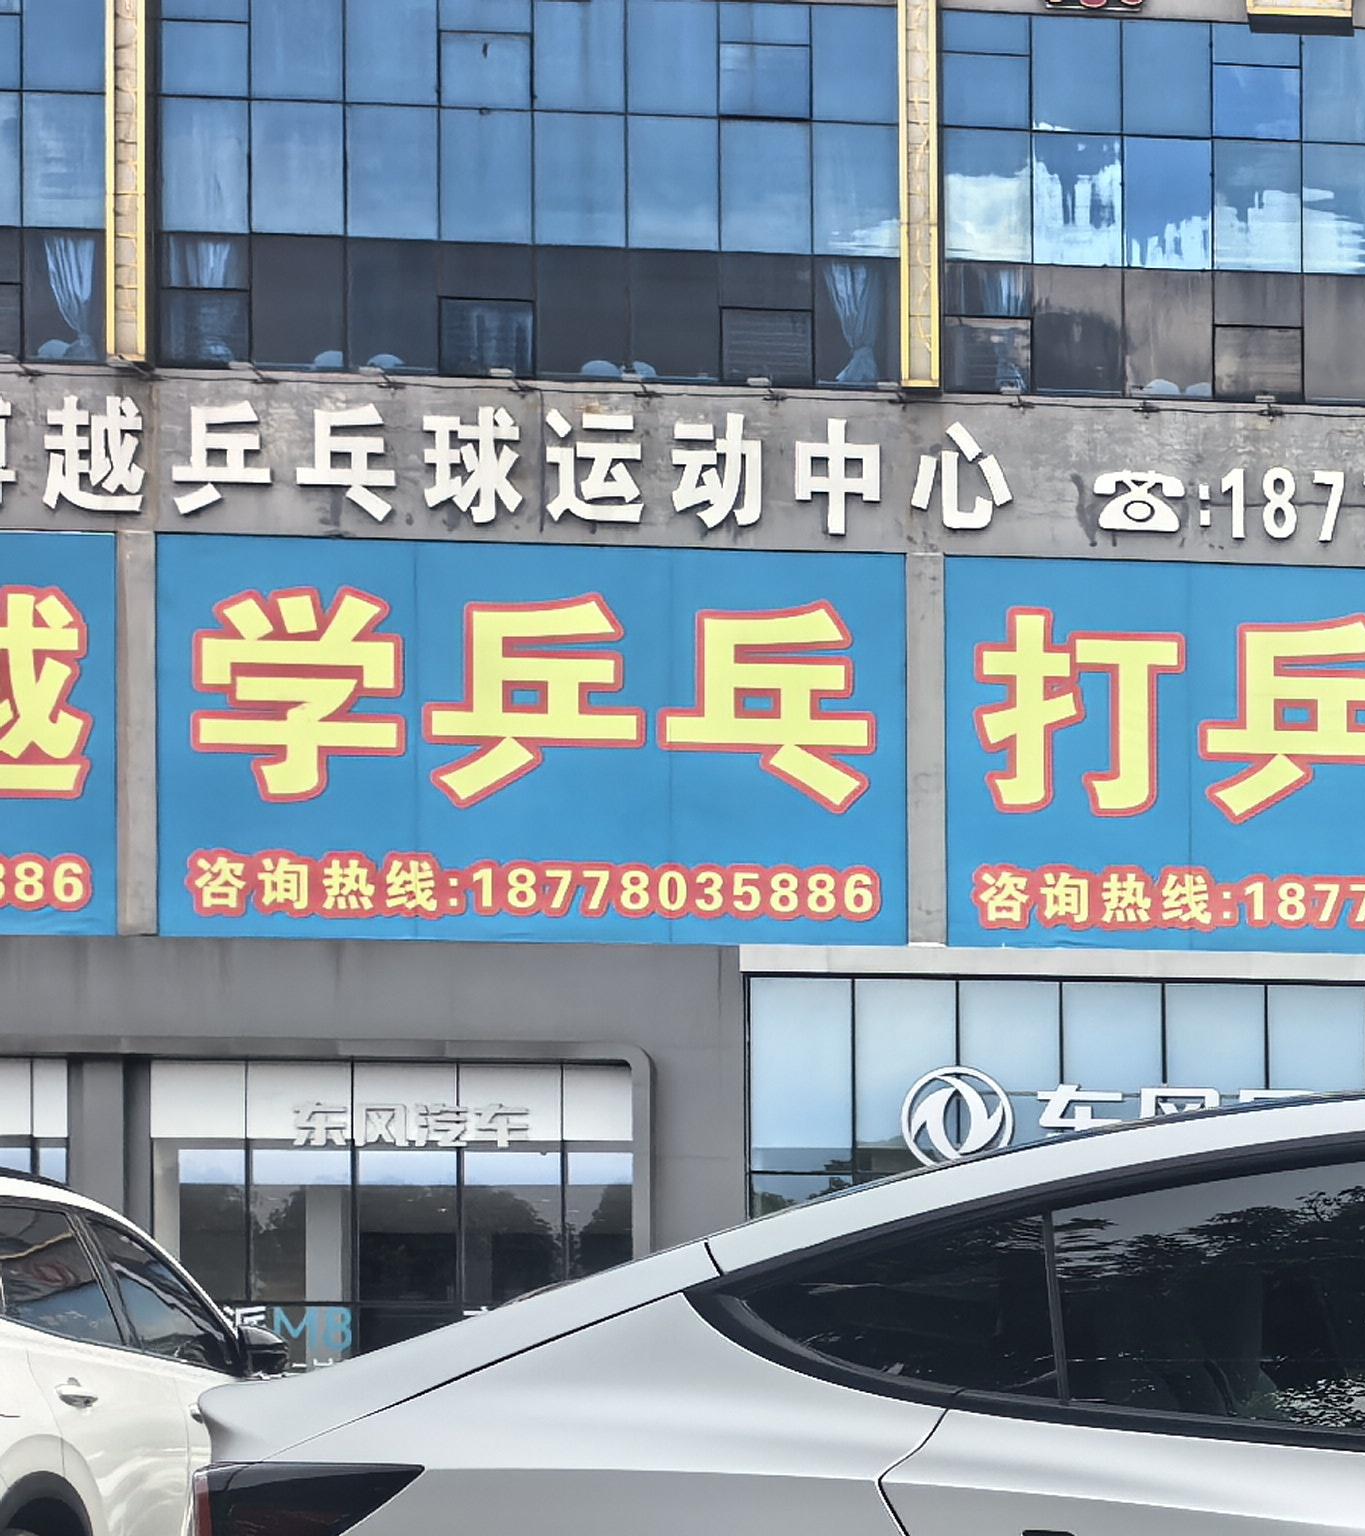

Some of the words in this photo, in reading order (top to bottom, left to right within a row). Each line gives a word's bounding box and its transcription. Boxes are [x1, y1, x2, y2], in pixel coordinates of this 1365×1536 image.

[0, 395, 1013, 537] 越乒乓球运动中心
[192, 587, 876, 814] 学乒乓
[0, 860, 88, 908] 86
[293, 1102, 530, 1148] 东风汽车
